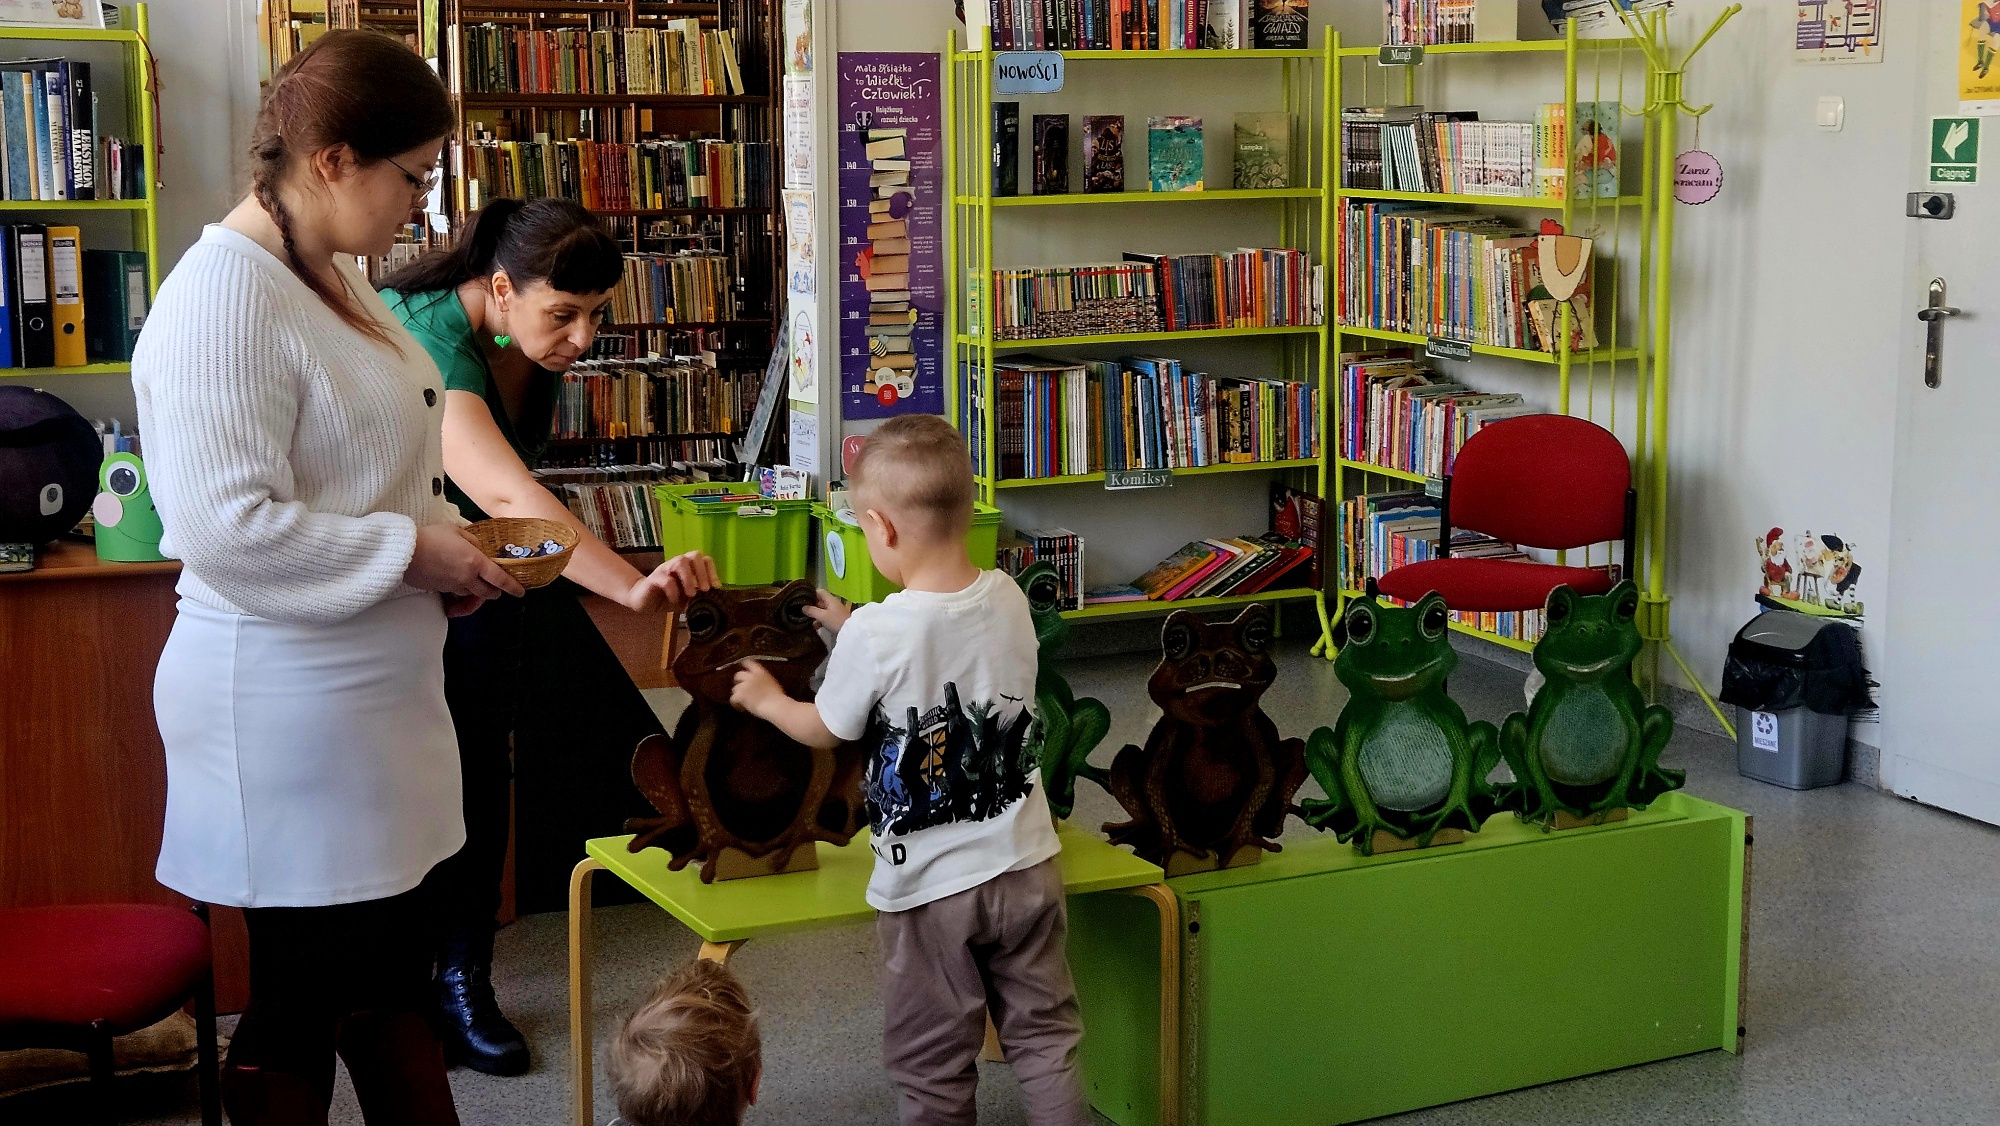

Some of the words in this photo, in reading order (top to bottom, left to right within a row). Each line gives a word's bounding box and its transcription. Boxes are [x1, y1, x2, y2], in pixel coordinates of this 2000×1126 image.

[1390, 48, 1412, 62] Mangi
[854, 64, 877, 73] Mała
[878, 63, 912, 74] Książka
[999, 58, 1059, 81] NOWOŚCI
[855, 78, 865, 86] to
[866, 73, 904, 87] Wielki
[875, 105, 904, 116] Książkowy
[880, 114, 899, 124] rozwój
[845, 123, 856, 132] 150
[1240, 144, 1263, 152] Lampka
[73, 128, 84, 189] MALARSTWA
[80, 129, 93, 189] LEKSYKON
[846, 161, 857, 170] 140
[1679, 164, 1710, 175] Zaraz
[1936, 167, 1971, 180] Ciągnąć
[846, 199, 857, 207] 130
[847, 236, 858, 245] 120
[849, 274, 859, 282] 110
[848, 311, 860, 319] 100
[850, 347, 860, 356] 90
[851, 384, 861, 393] 80
[1110, 472, 1169, 487] Komiksy
[1754, 736, 1778, 748] MIESZANE
